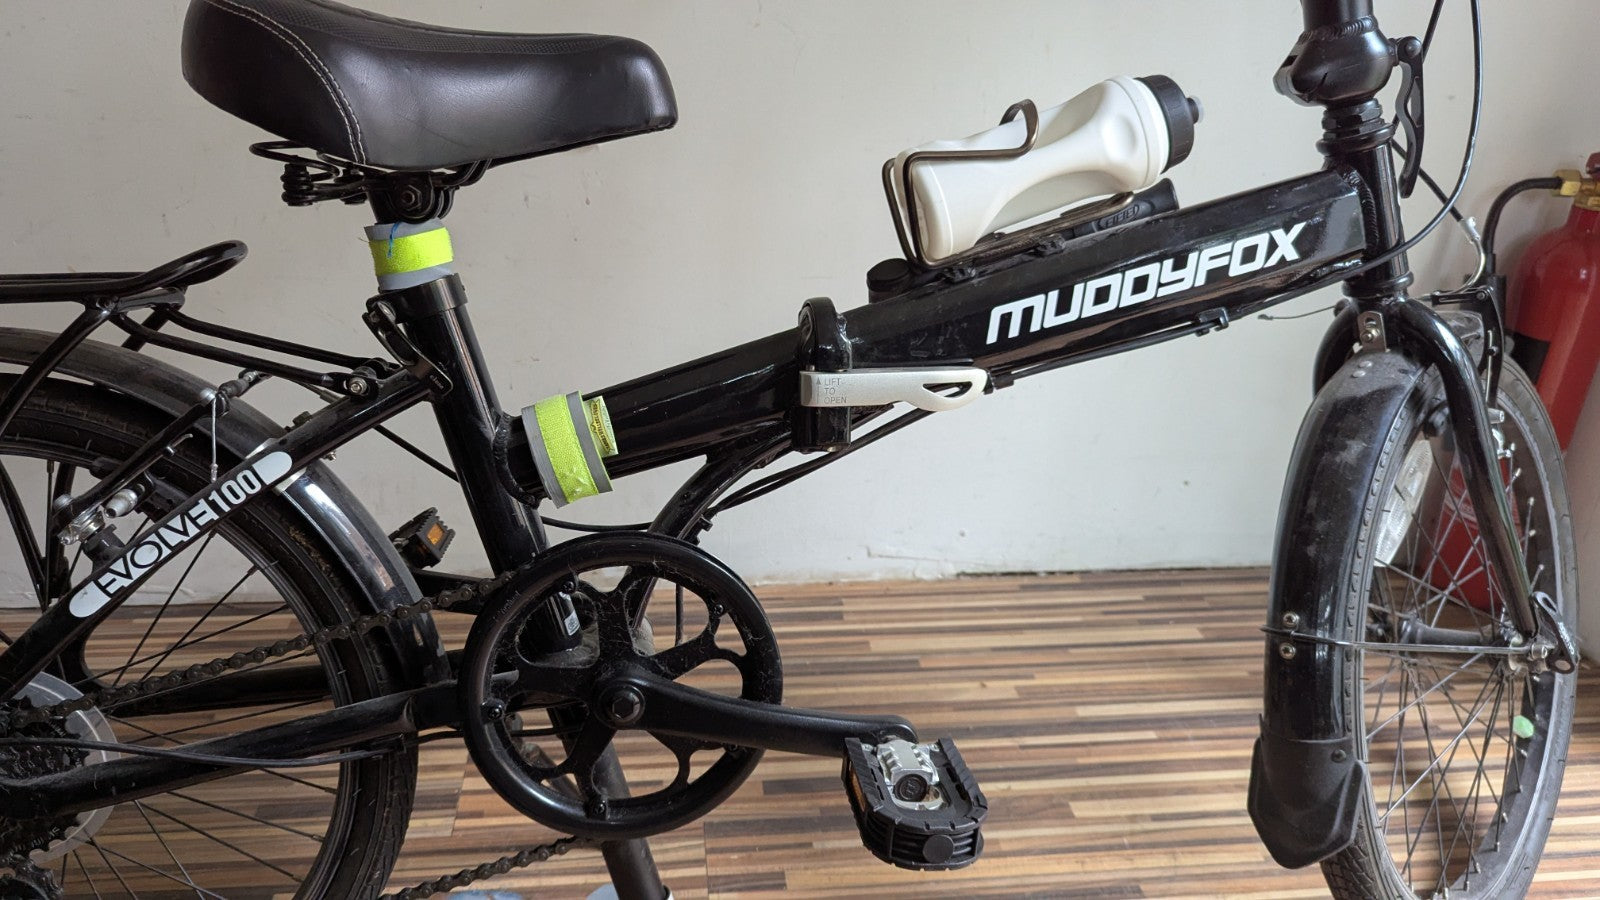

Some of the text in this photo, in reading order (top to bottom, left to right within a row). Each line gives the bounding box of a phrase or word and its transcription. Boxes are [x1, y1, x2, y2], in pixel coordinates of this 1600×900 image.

[986, 222, 1306, 345] MUDDYFOX
[824, 377, 841, 386] LIFT
[823, 387, 836, 395] TO
[823, 396, 847, 404] OPEN
